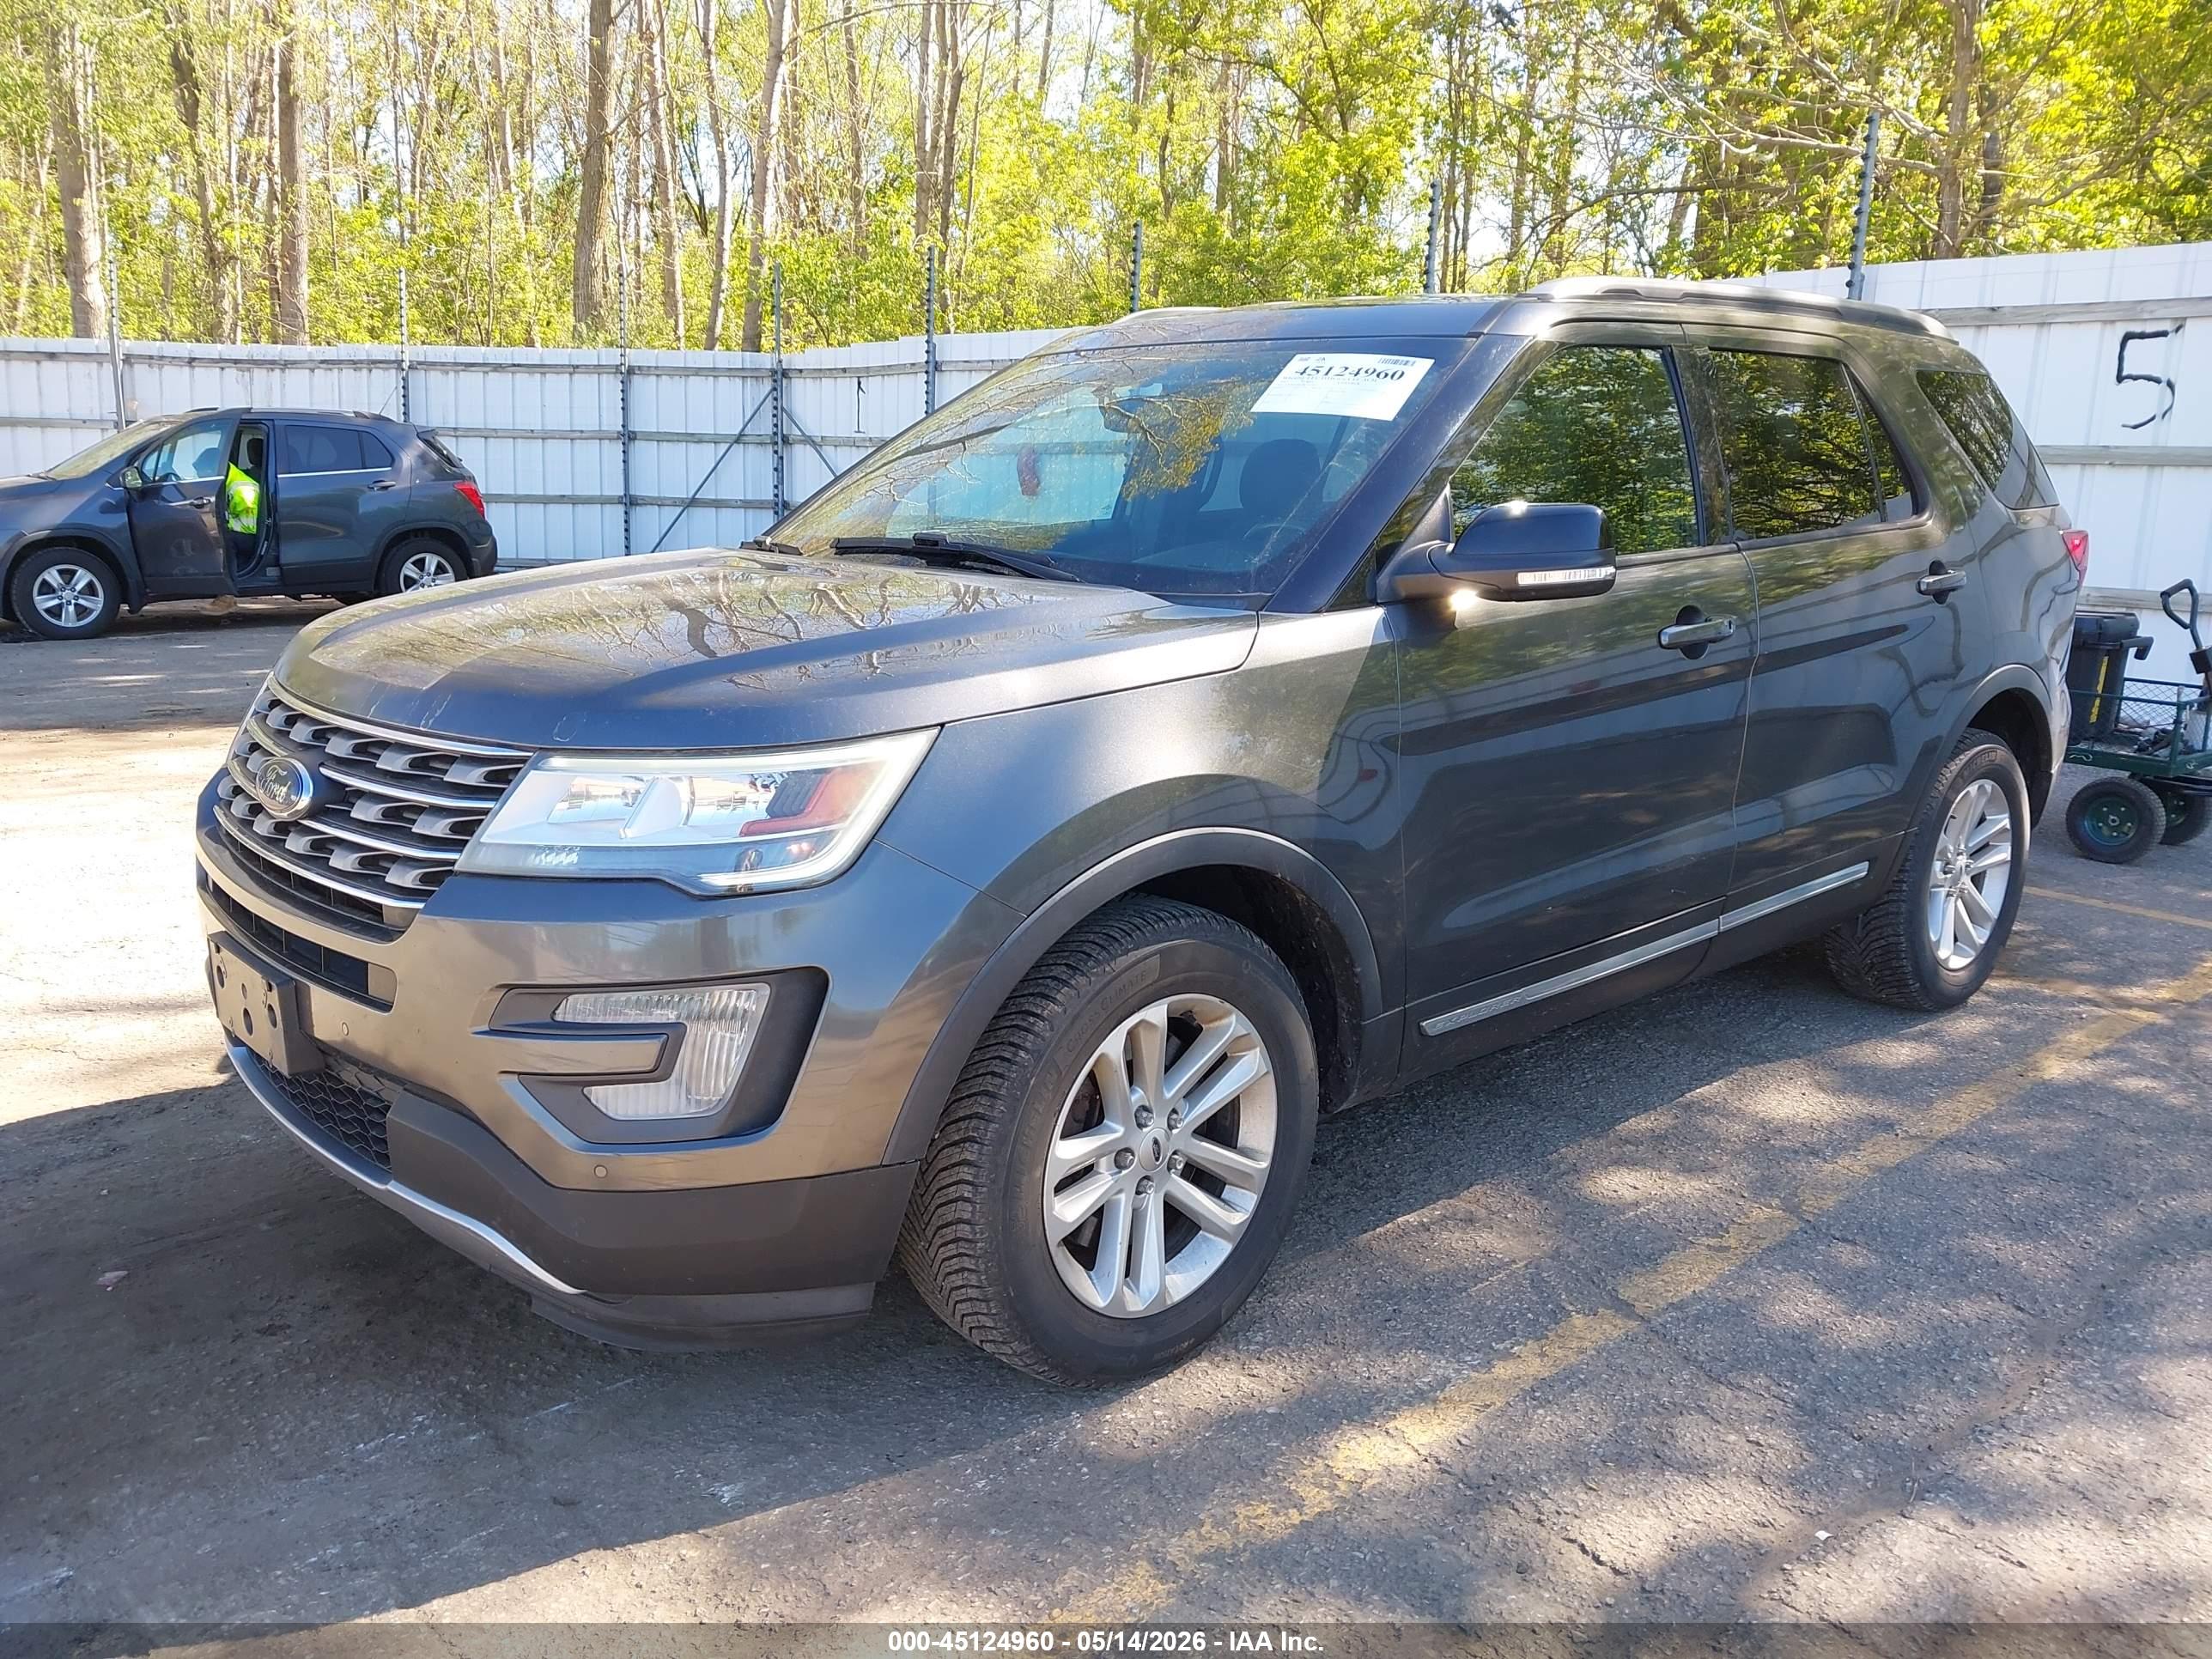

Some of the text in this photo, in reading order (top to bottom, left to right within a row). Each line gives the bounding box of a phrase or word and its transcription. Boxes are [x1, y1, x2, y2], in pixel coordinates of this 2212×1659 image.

[1295, 365, 1405, 381] 45124960
[2116, 324, 2185, 429] 5
[260, 764, 292, 804] Ford
